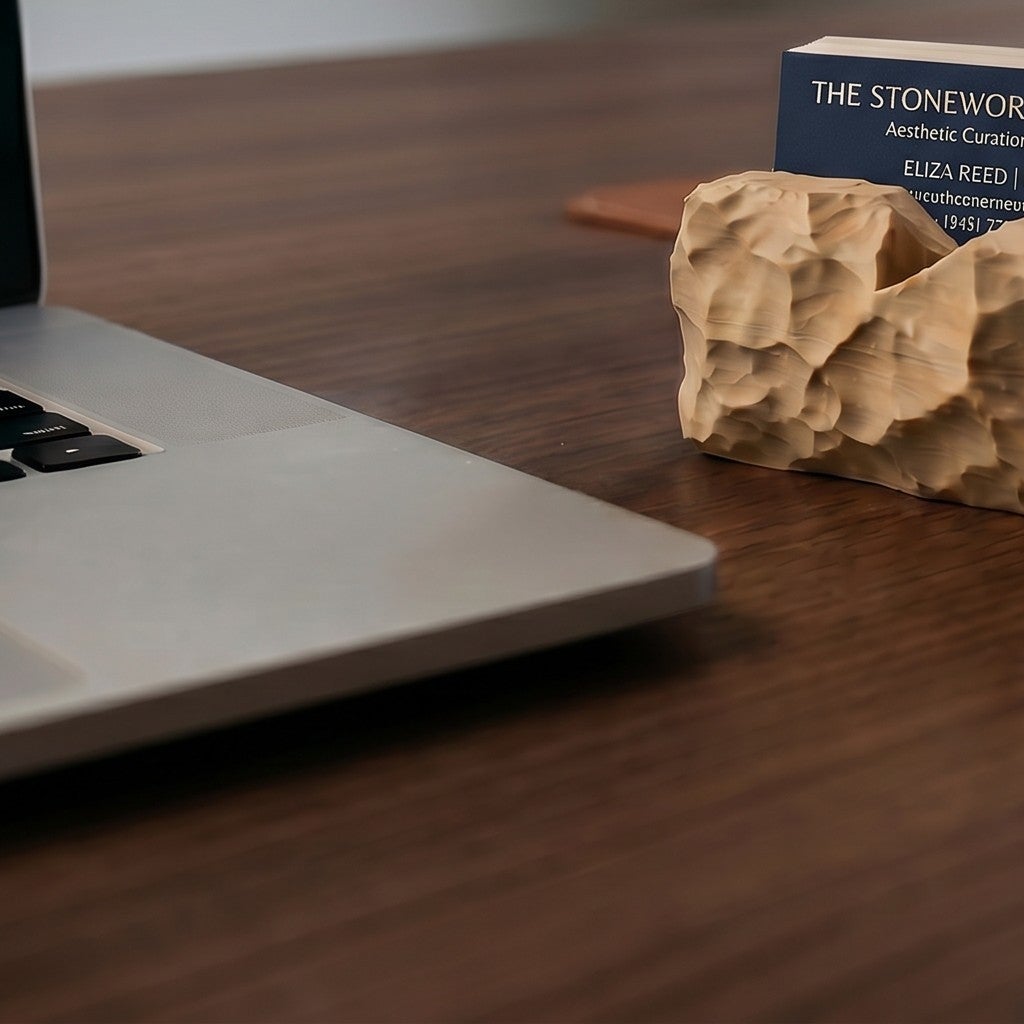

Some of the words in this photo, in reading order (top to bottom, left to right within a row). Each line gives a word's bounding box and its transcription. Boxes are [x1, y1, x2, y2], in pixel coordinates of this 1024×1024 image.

[811, 80, 862, 107] THE
[885, 121, 958, 143] Aesthetic
[903, 159, 953, 181] ELIZA
[958, 164, 1008, 186] REED
